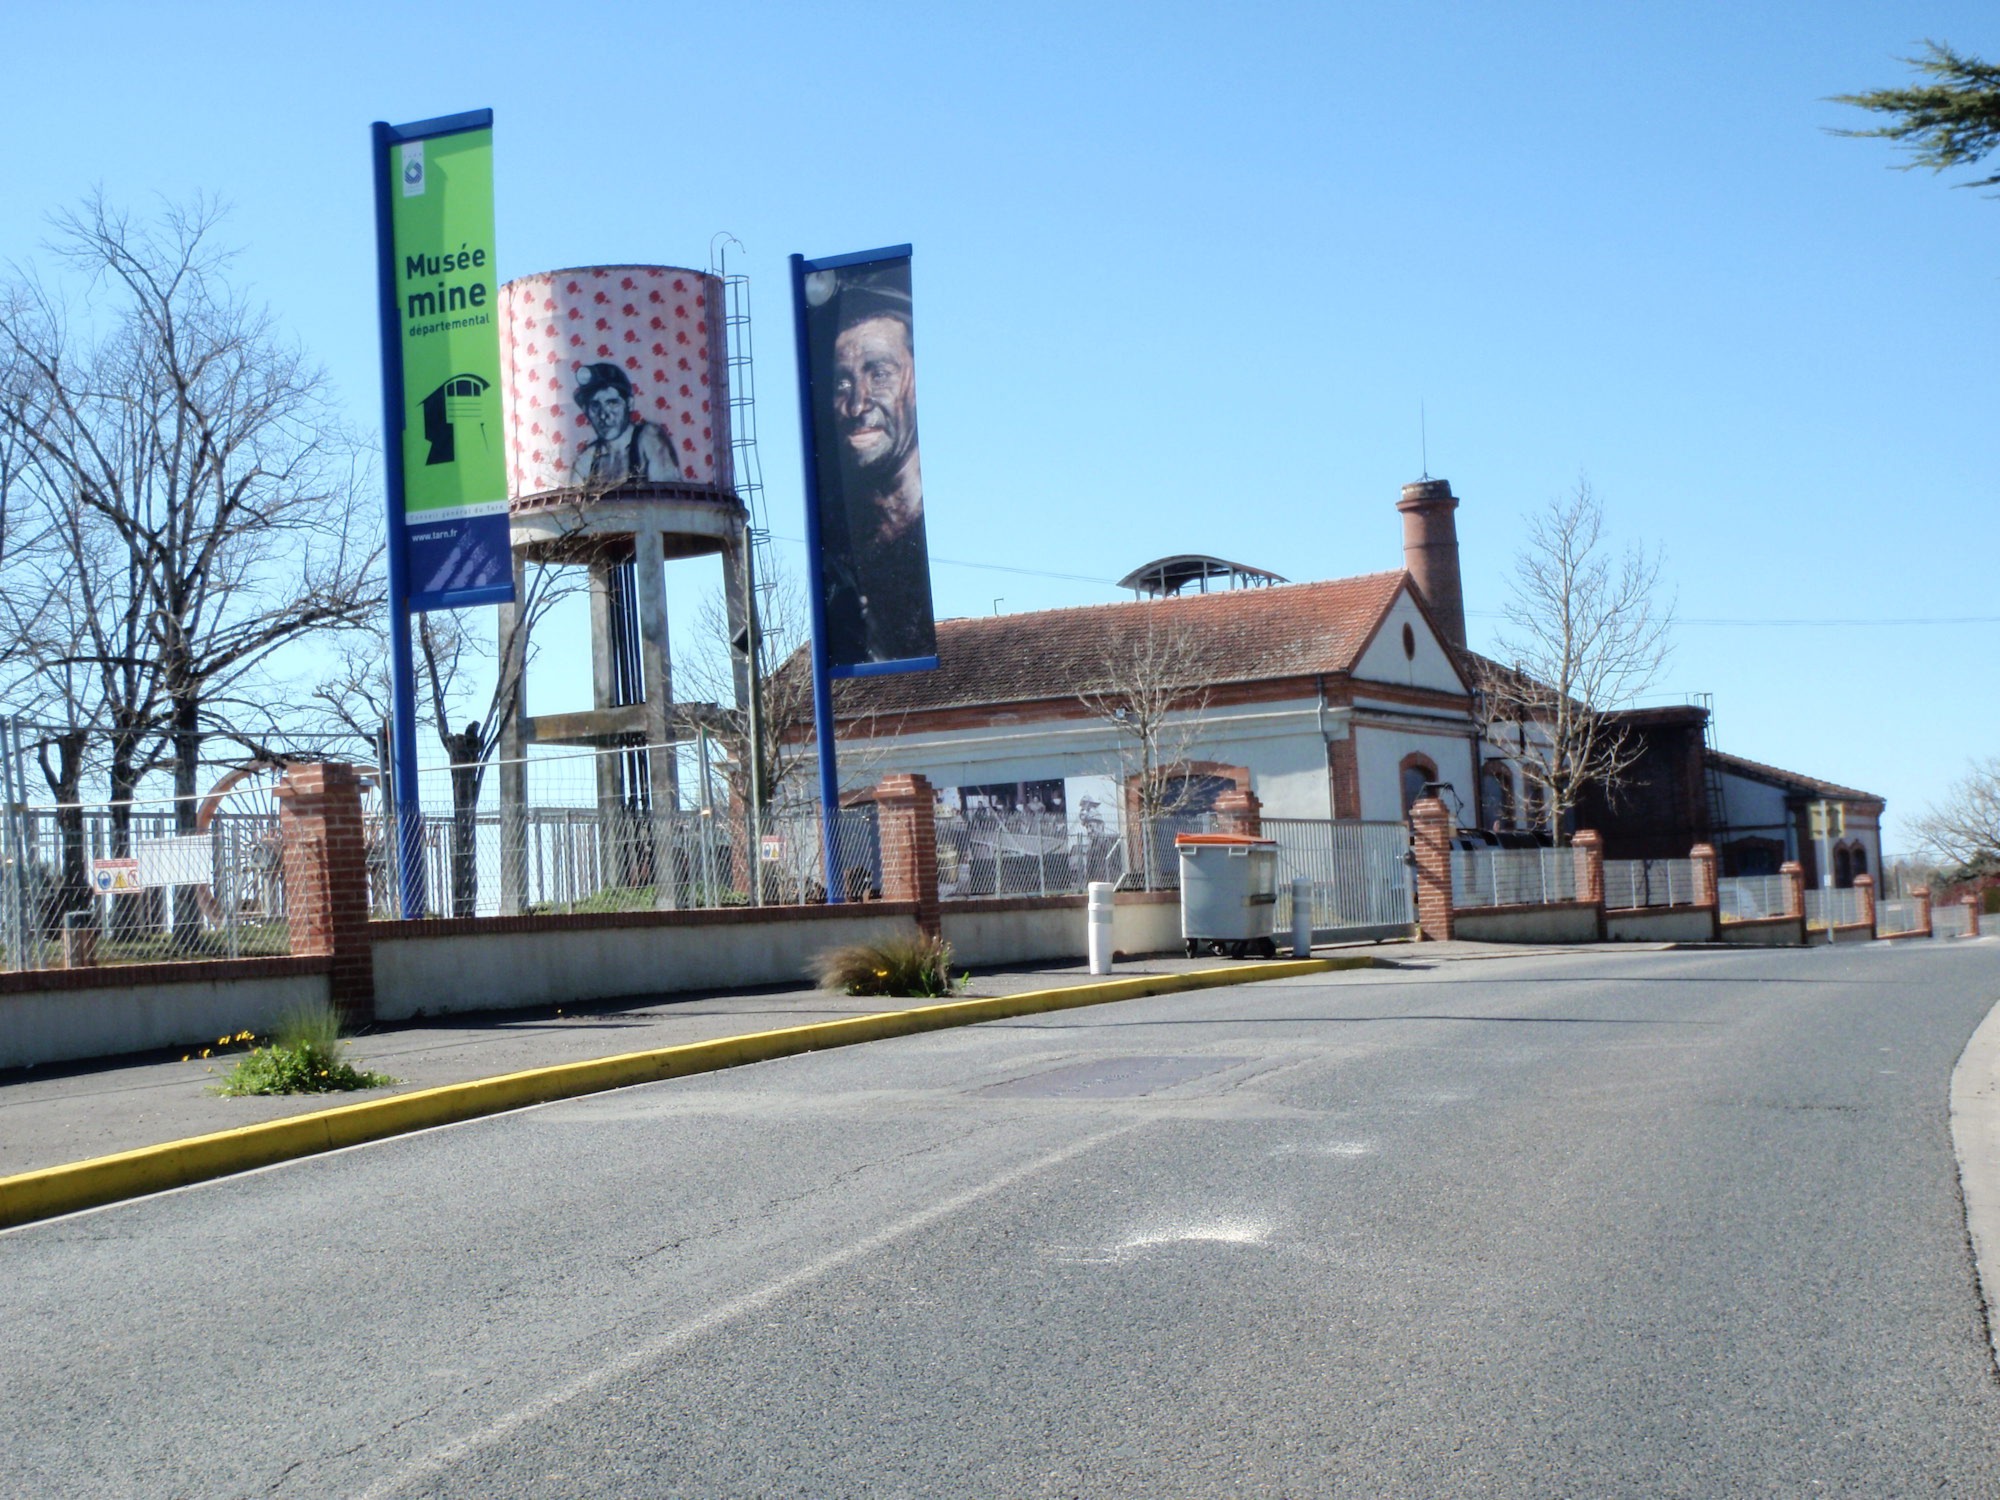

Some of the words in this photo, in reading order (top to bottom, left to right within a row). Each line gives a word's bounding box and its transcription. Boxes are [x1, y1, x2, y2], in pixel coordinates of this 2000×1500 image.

[406, 243, 486, 280] Musée
[408, 281, 486, 318] mine
[409, 313, 490, 337] départemental
[411, 528, 458, 542] www.tarn.fr
